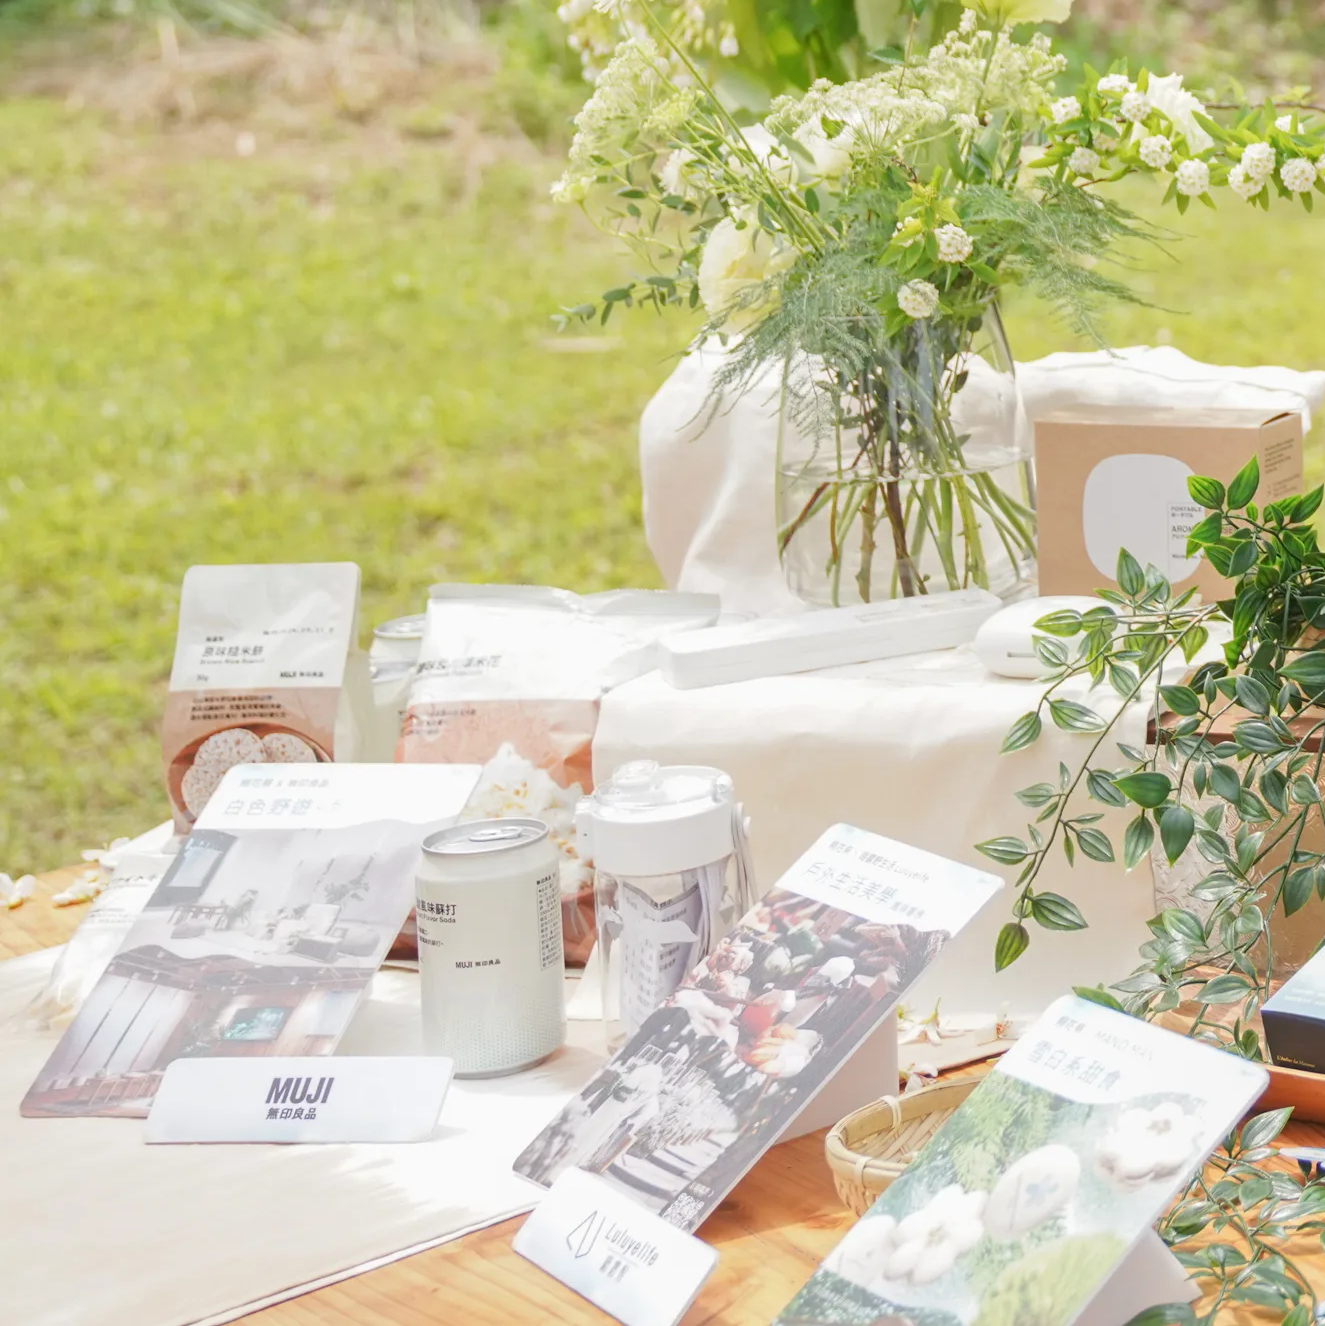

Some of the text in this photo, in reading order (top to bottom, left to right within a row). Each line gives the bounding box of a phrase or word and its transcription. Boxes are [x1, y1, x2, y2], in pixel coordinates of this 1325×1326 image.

[800, 861, 898, 905] 戶外生活美學
[439, 916, 456, 924] Soda
[455, 961, 473, 969] MUJI
[1028, 1039, 1121, 1092] 雪白系甜食
[265, 1077, 335, 1104] MUJI
[265, 1107, 317, 1120] 無印良品
[605, 1221, 660, 1267] Luluyelife
